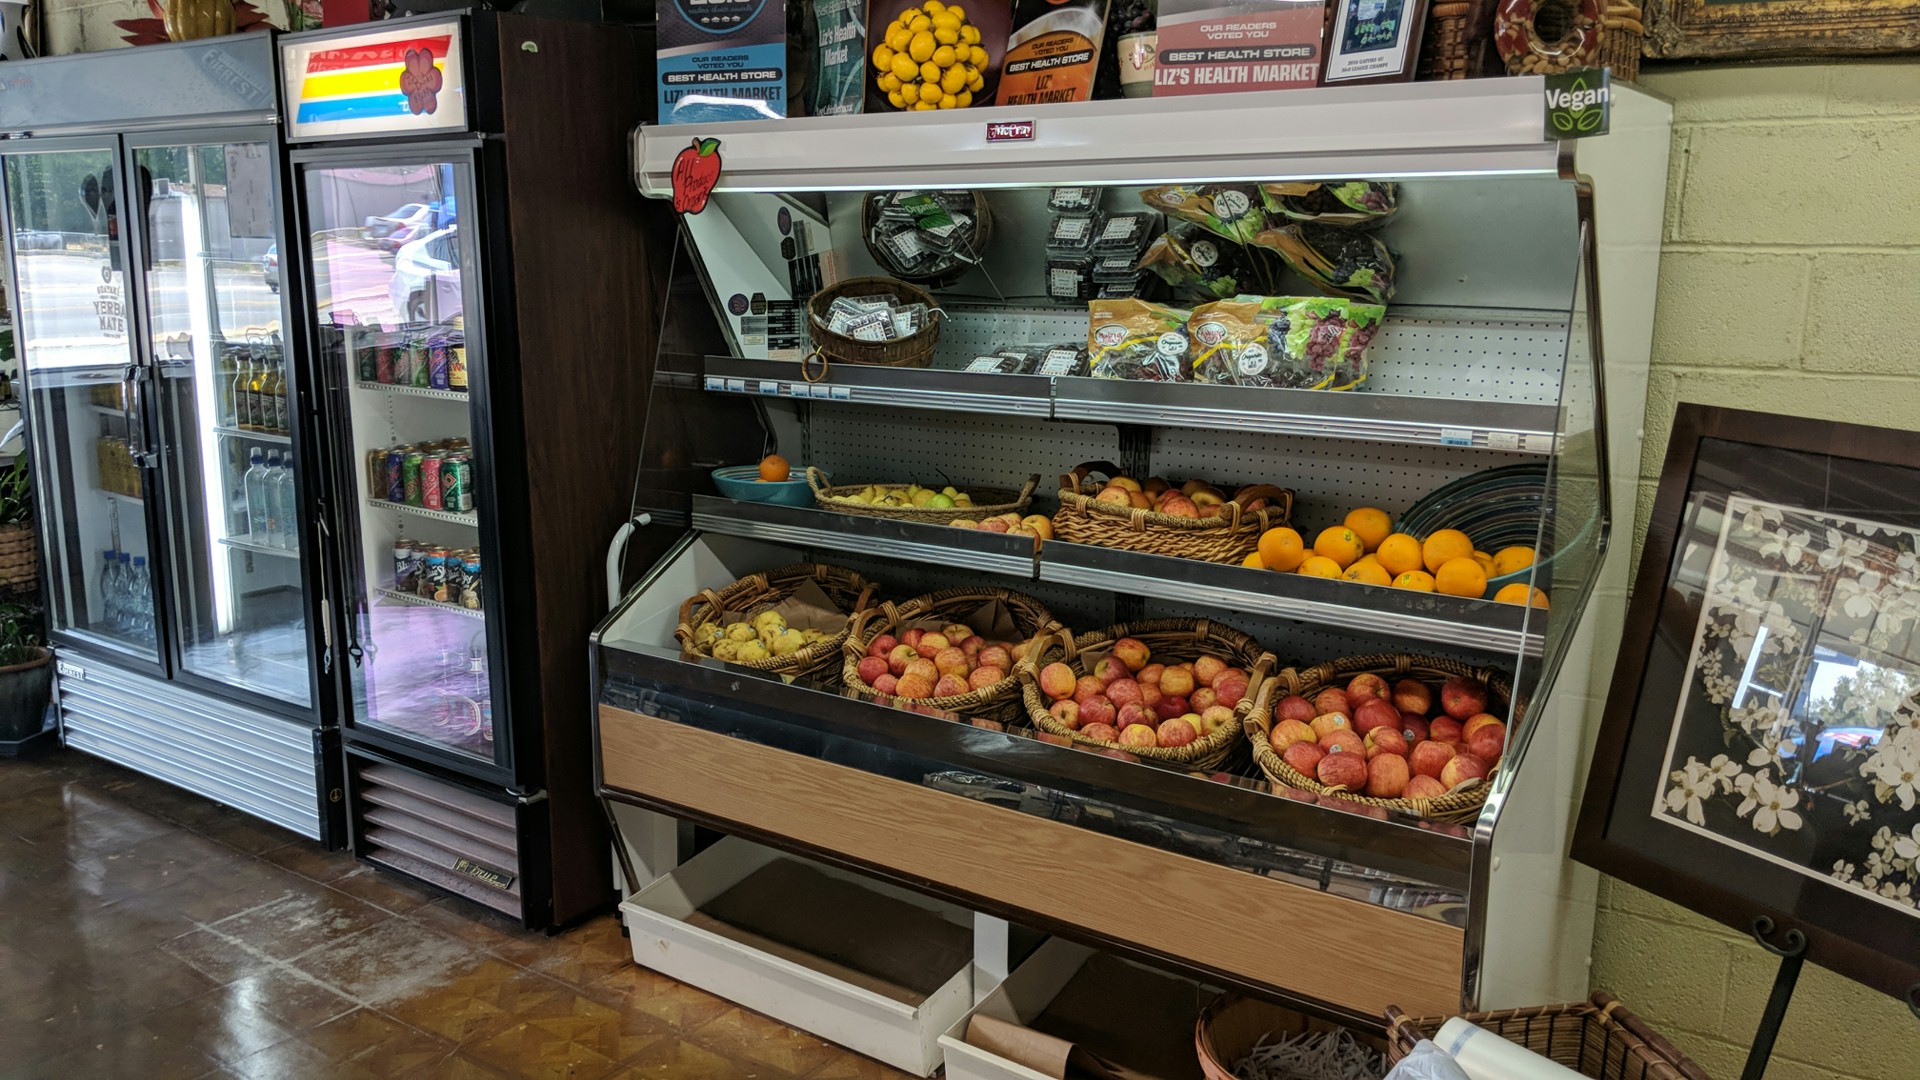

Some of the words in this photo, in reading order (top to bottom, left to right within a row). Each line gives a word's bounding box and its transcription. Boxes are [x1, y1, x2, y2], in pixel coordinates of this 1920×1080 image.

[834, 22, 856, 42] Health
[1200, 24, 1222, 33] OUR
[1226, 22, 1277, 31] READERS
[1207, 32, 1243, 40] VOTED
[1246, 31, 1269, 39] YOU
[1046, 37, 1074, 47] READERS
[825, 45, 848, 67] Market
[1034, 47, 1055, 56] VOTED
[1055, 45, 1069, 53] YOU
[1169, 51, 1204, 62] BEST
[1207, 49, 1260, 60] HEALTH
[1263, 47, 1311, 59] STORE
[1009, 63, 1030, 72] BEST
[1030, 57, 1062, 69] HEALTH
[1062, 52, 1090, 64] STORE
[668, 74, 696, 83] BEST
[698, 72, 738, 81] HEALTH
[740, 71, 777, 80] STORE
[1154, 67, 1190, 86] LIZ'S
[1193, 65, 1248, 85] HEALTH
[1253, 63, 1320, 83] MARKET
[732, 86, 782, 101] MARKET
[1038, 87, 1077, 105] MARKET
[1545, 87, 1609, 111] Vegan
[904, 202, 939, 214] Organic
[93, 301, 126, 318] YERBA
[99, 316, 124, 333] MATE
